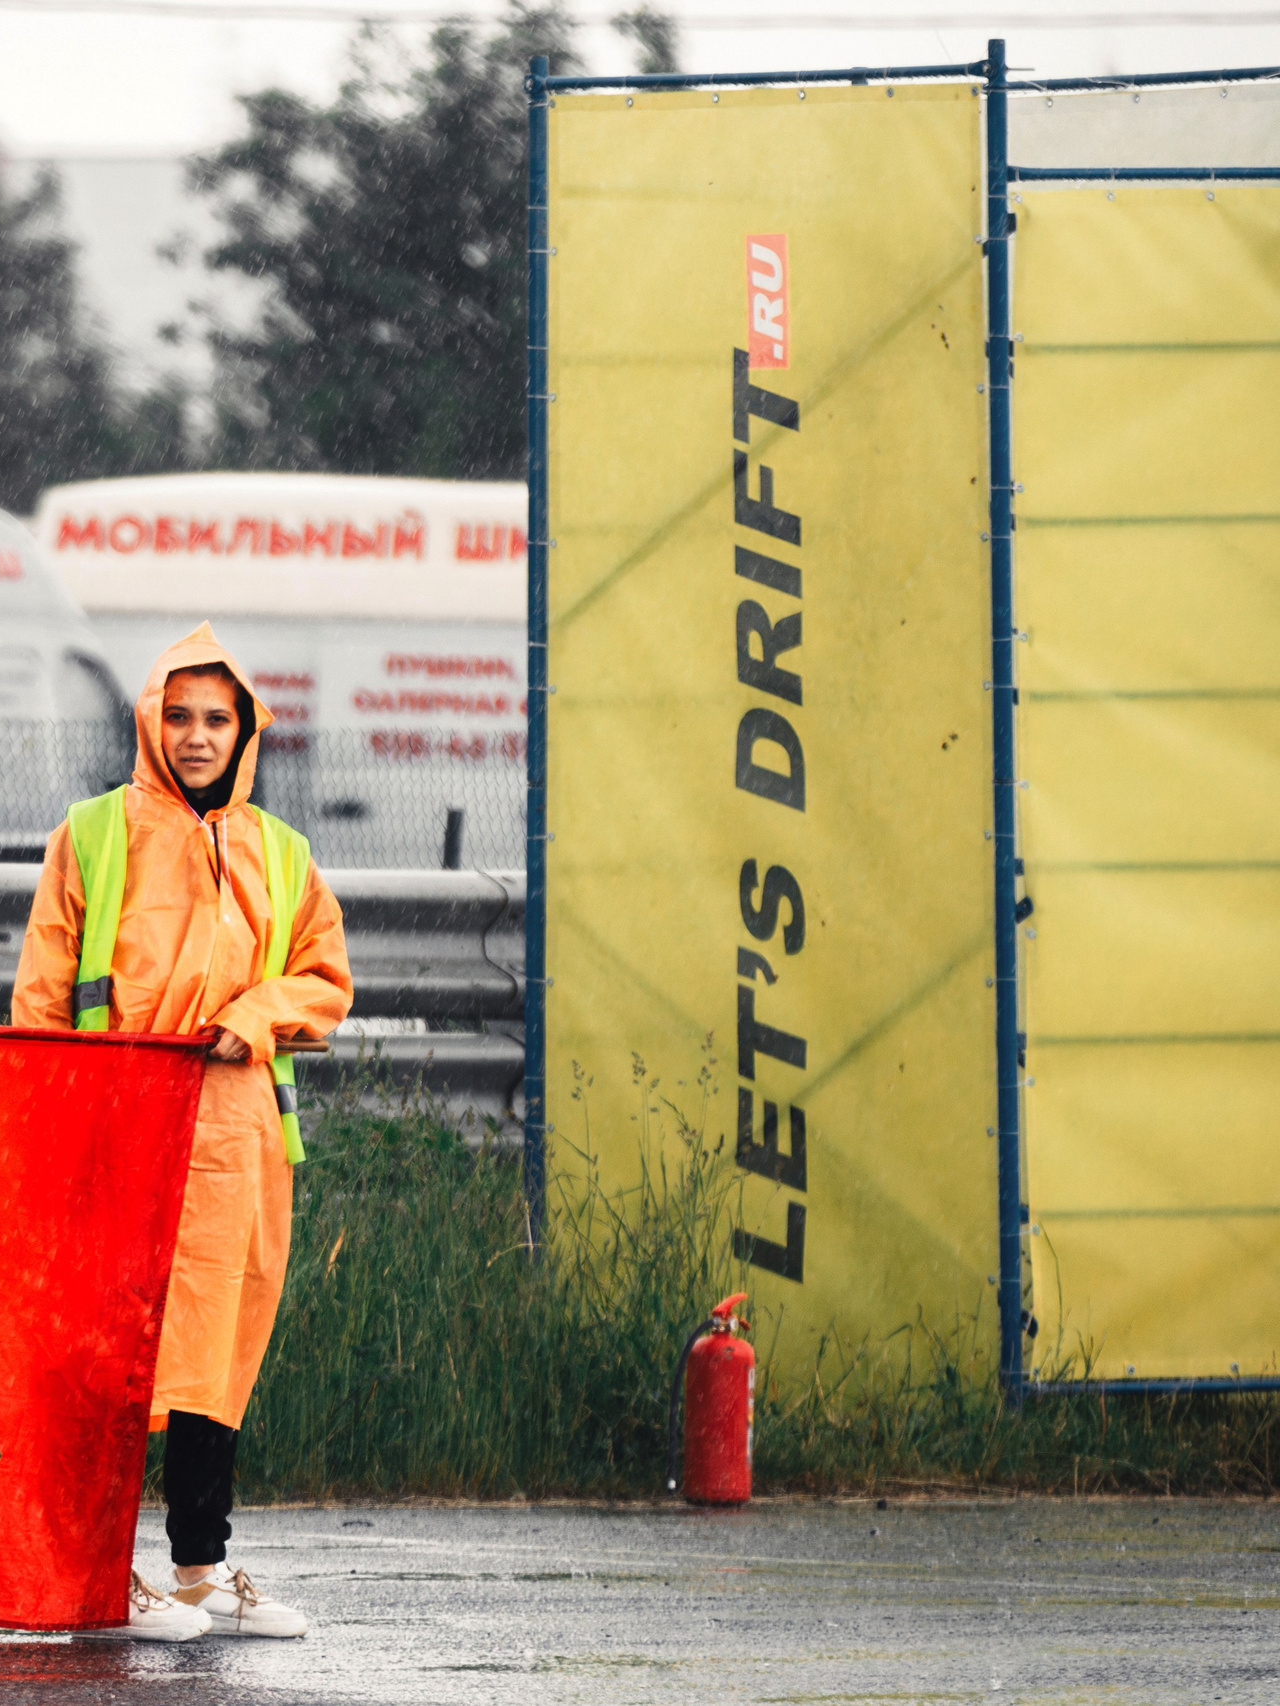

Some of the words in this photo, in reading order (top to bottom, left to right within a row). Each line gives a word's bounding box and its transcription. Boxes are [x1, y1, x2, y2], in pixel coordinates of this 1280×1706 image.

[54, 509, 426, 562] МОБИЛЬНЫЙ
[732, 346, 806, 813] DRIFT
[733, 857, 809, 1284] LET'S
